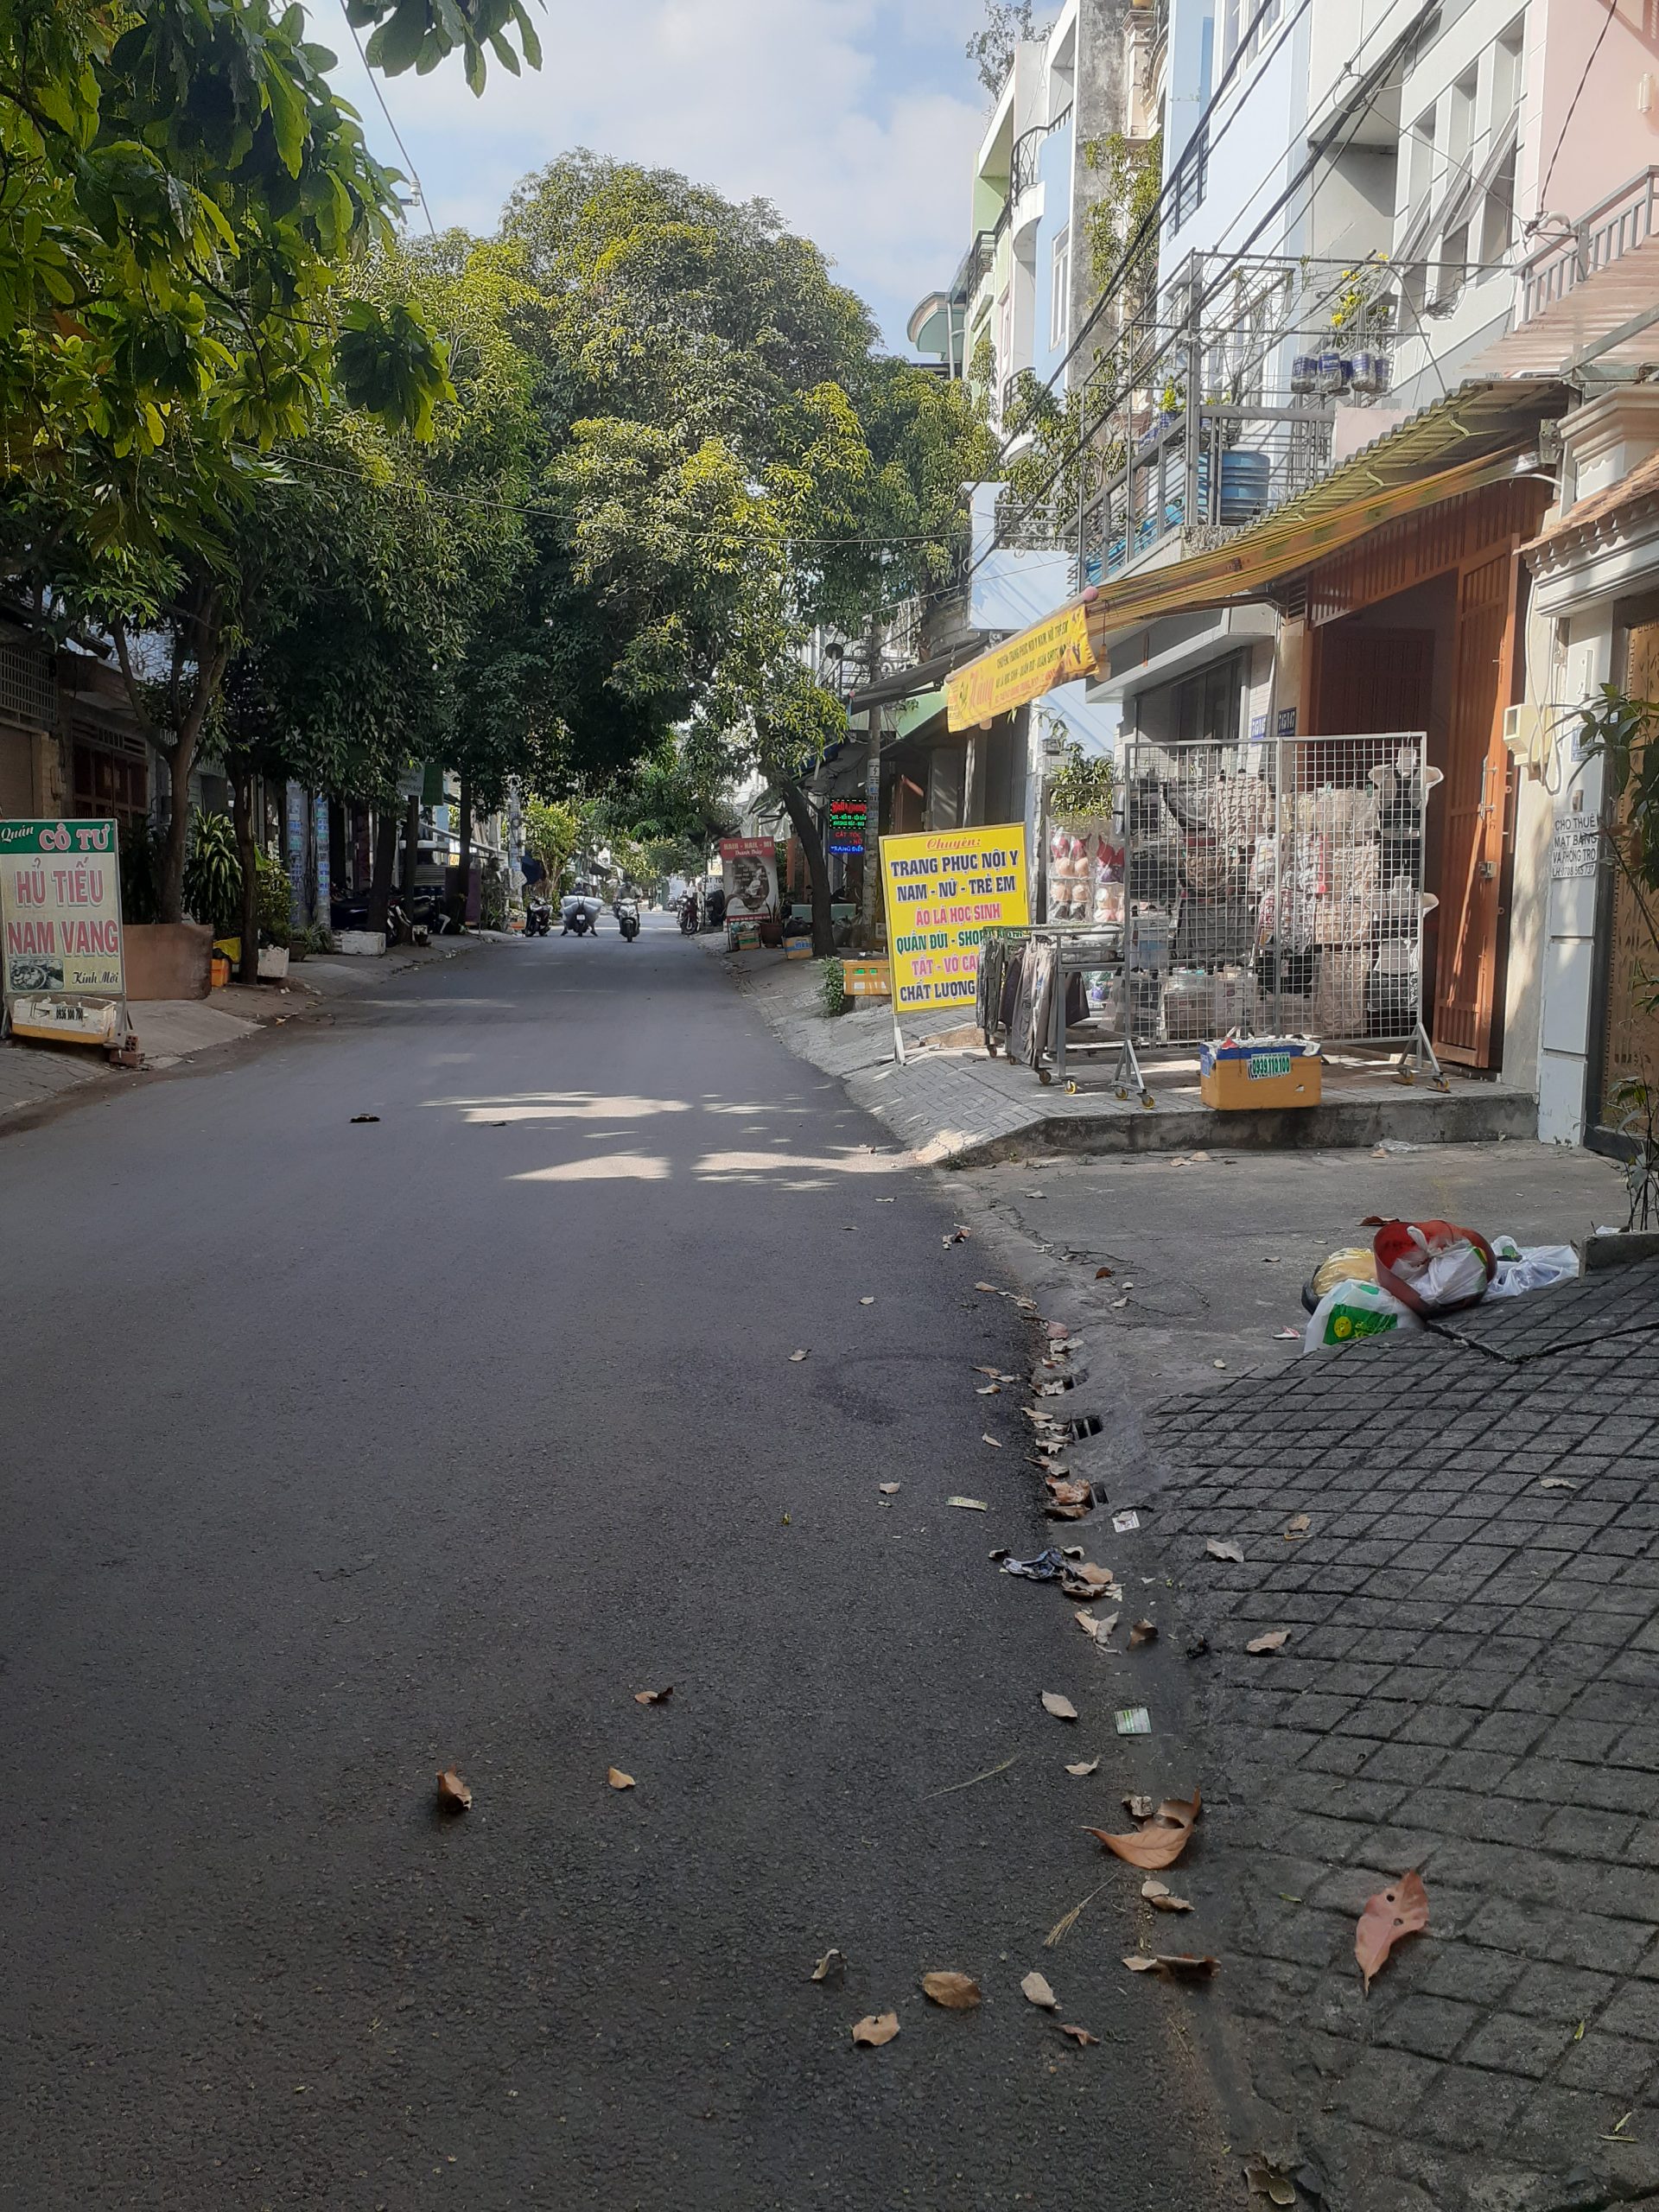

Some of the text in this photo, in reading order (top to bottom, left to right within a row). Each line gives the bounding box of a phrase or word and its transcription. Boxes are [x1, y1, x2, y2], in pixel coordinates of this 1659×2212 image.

[1, 823, 110, 850] Quán CÔ TƯ
[1554, 818, 1572, 830] CHO
[891, 849, 1018, 877] TRANG PHỤC NỘI Y
[16, 856, 104, 905] HỦ TIẾU
[897, 884, 927, 902] NAM
[938, 878, 958, 898] NỮ
[969, 874, 993, 895] TRẺ
[996, 875, 1016, 892] EM
[916, 904, 1001, 925] ÁO LÁ HỌC SINH
[7, 920, 118, 956] NAM VANG
[897, 931, 926, 955] QUẦN
[930, 930, 949, 950] ĐÙI
[72, 971, 119, 984] Kính Mời
[900, 979, 976, 1001] CHẤT LƯỢNG
